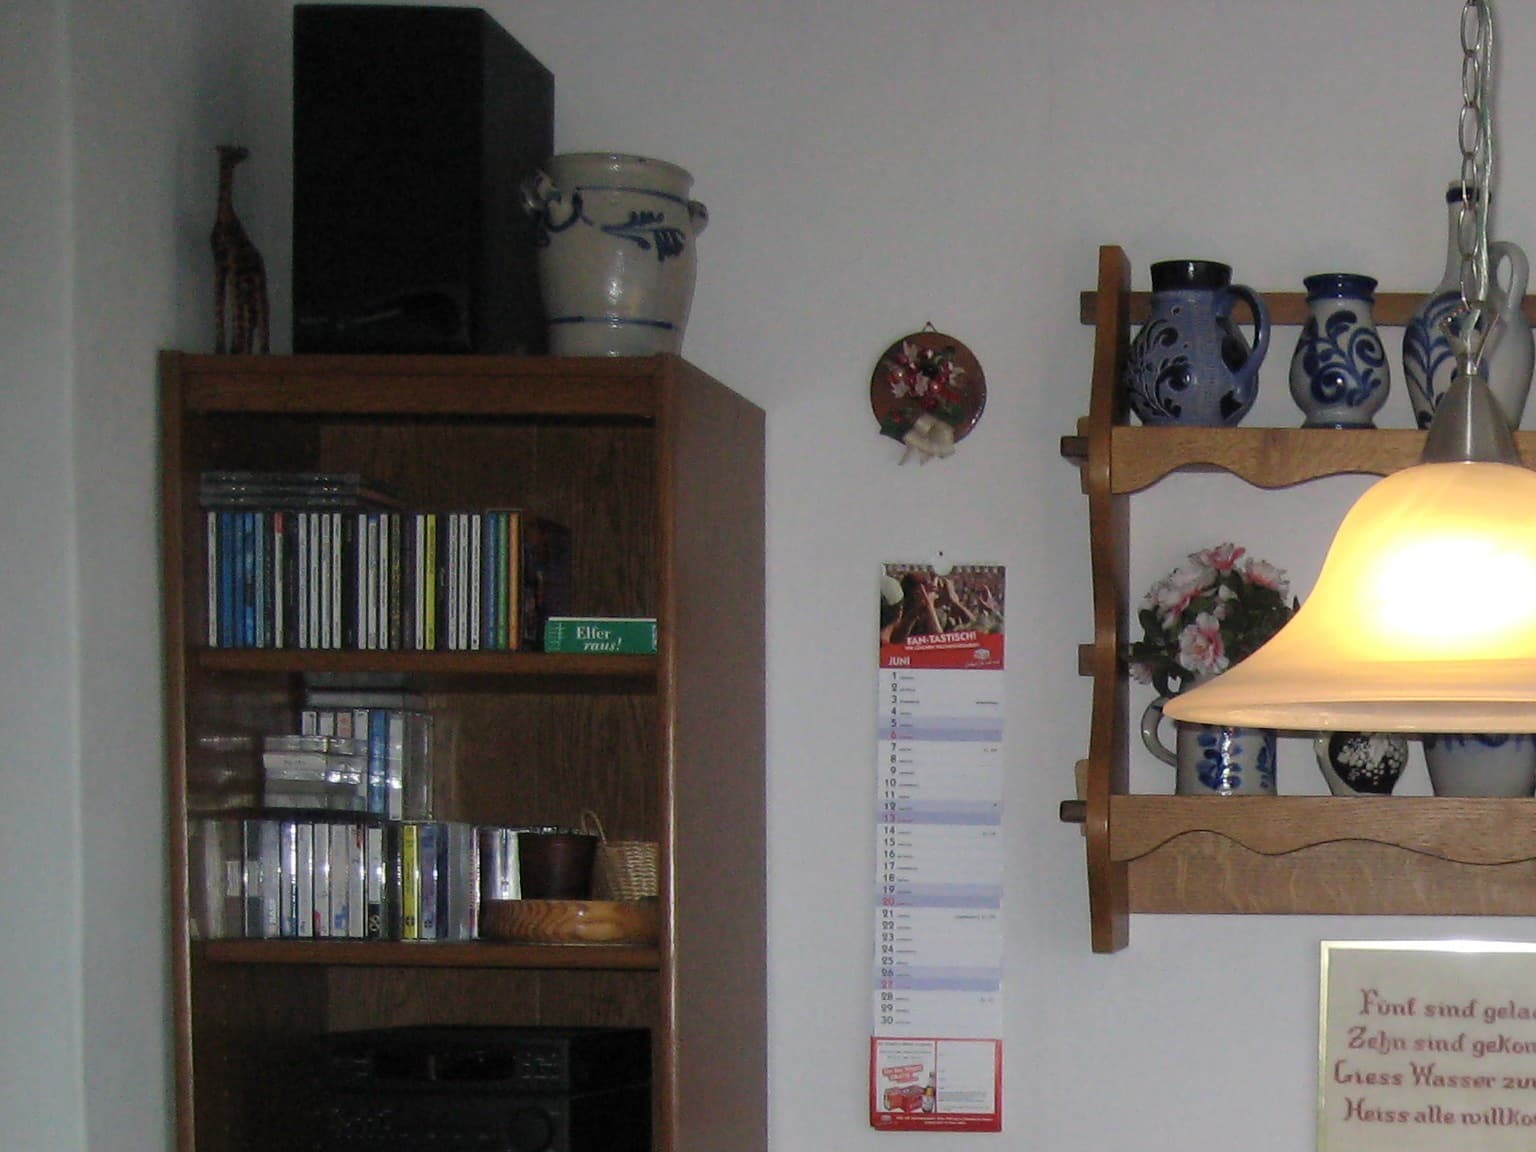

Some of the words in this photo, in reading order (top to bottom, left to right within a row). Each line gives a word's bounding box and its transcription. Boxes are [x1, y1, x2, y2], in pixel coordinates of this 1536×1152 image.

[576, 625, 611, 640] Elfer
[583, 637, 622, 651] raus!
[888, 656, 910, 666] JUNI
[884, 778, 896, 787] 10
[884, 790, 895, 799] 11
[884, 802, 896, 811] 12
[884, 826, 895, 835] 14
[884, 838, 896, 847] 15
[884, 850, 896, 859] 16
[884, 862, 895, 870] 17
[883, 885, 895, 894] 19
[882, 909, 894, 918] 21
[882, 921, 894, 930] 22
[882, 932, 894, 942] 23
[882, 944, 894, 953] 24
[881, 956, 894, 966] 25
[881, 968, 894, 977] 26
[881, 1003, 893, 1013] 29
[1424, 998, 1478, 1018] sind
[880, 1015, 894, 1025] 30
[1348, 1025, 1406, 1055] Zehn
[1414, 1033, 1466, 1052] sind
[1409, 1061, 1496, 1089] Wasser
[1344, 1096, 1409, 1123] Heiss
[1414, 1104, 1455, 1124] alle
